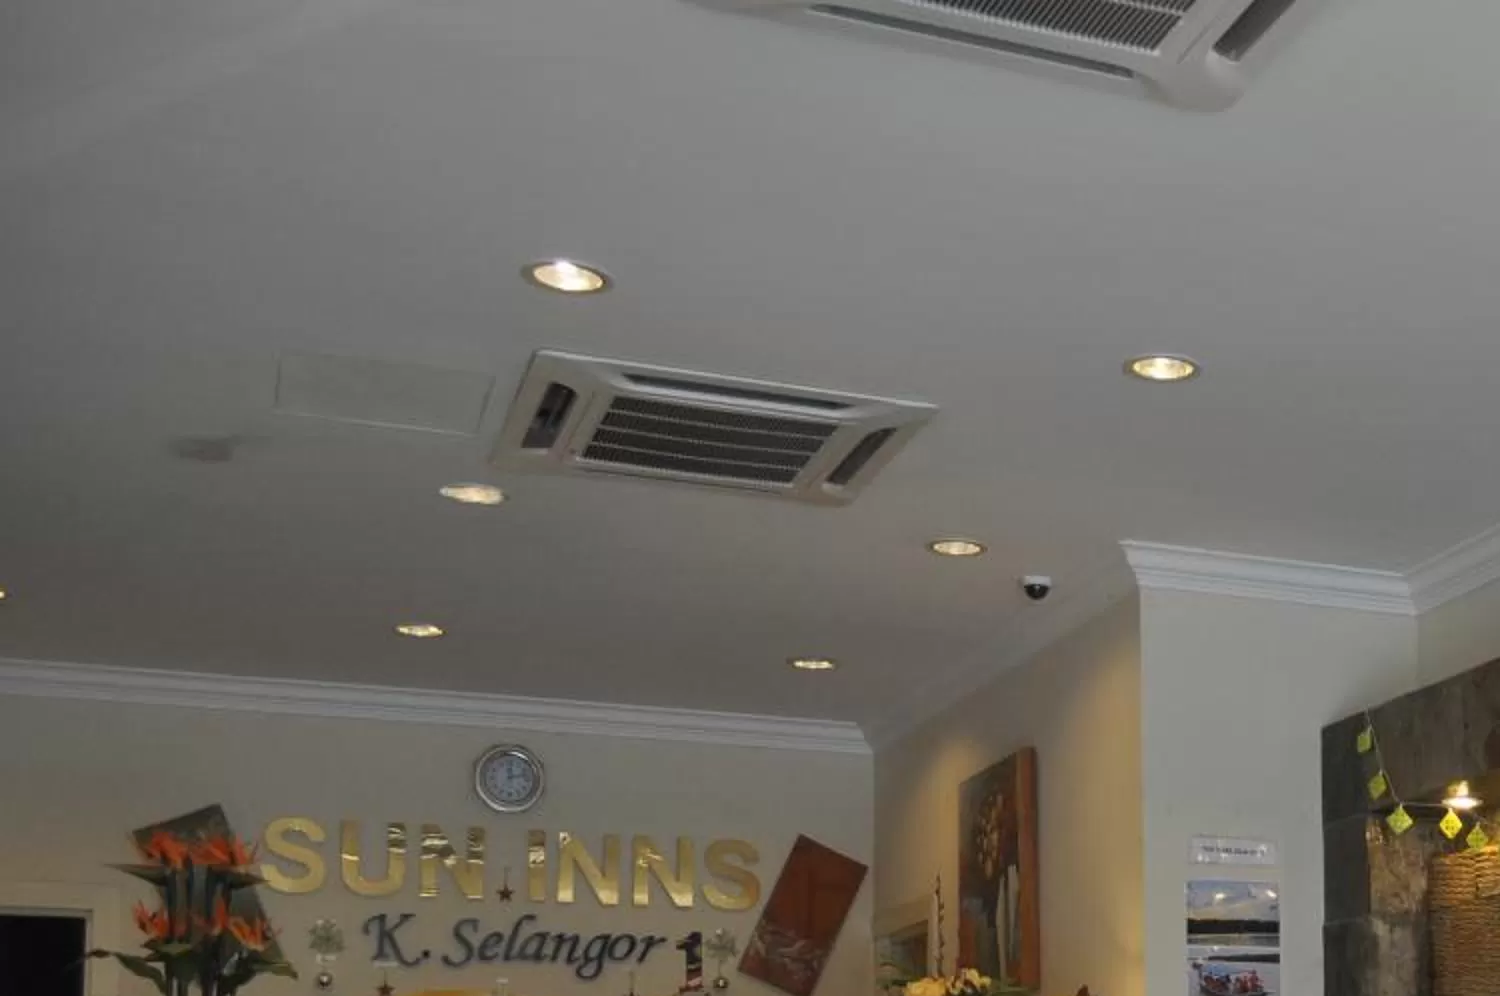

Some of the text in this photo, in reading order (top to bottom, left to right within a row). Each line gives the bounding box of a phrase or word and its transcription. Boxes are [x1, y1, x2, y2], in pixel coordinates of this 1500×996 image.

[260, 816, 762, 911] SUN INNS
[361, 912, 667, 981] K. Selangor
